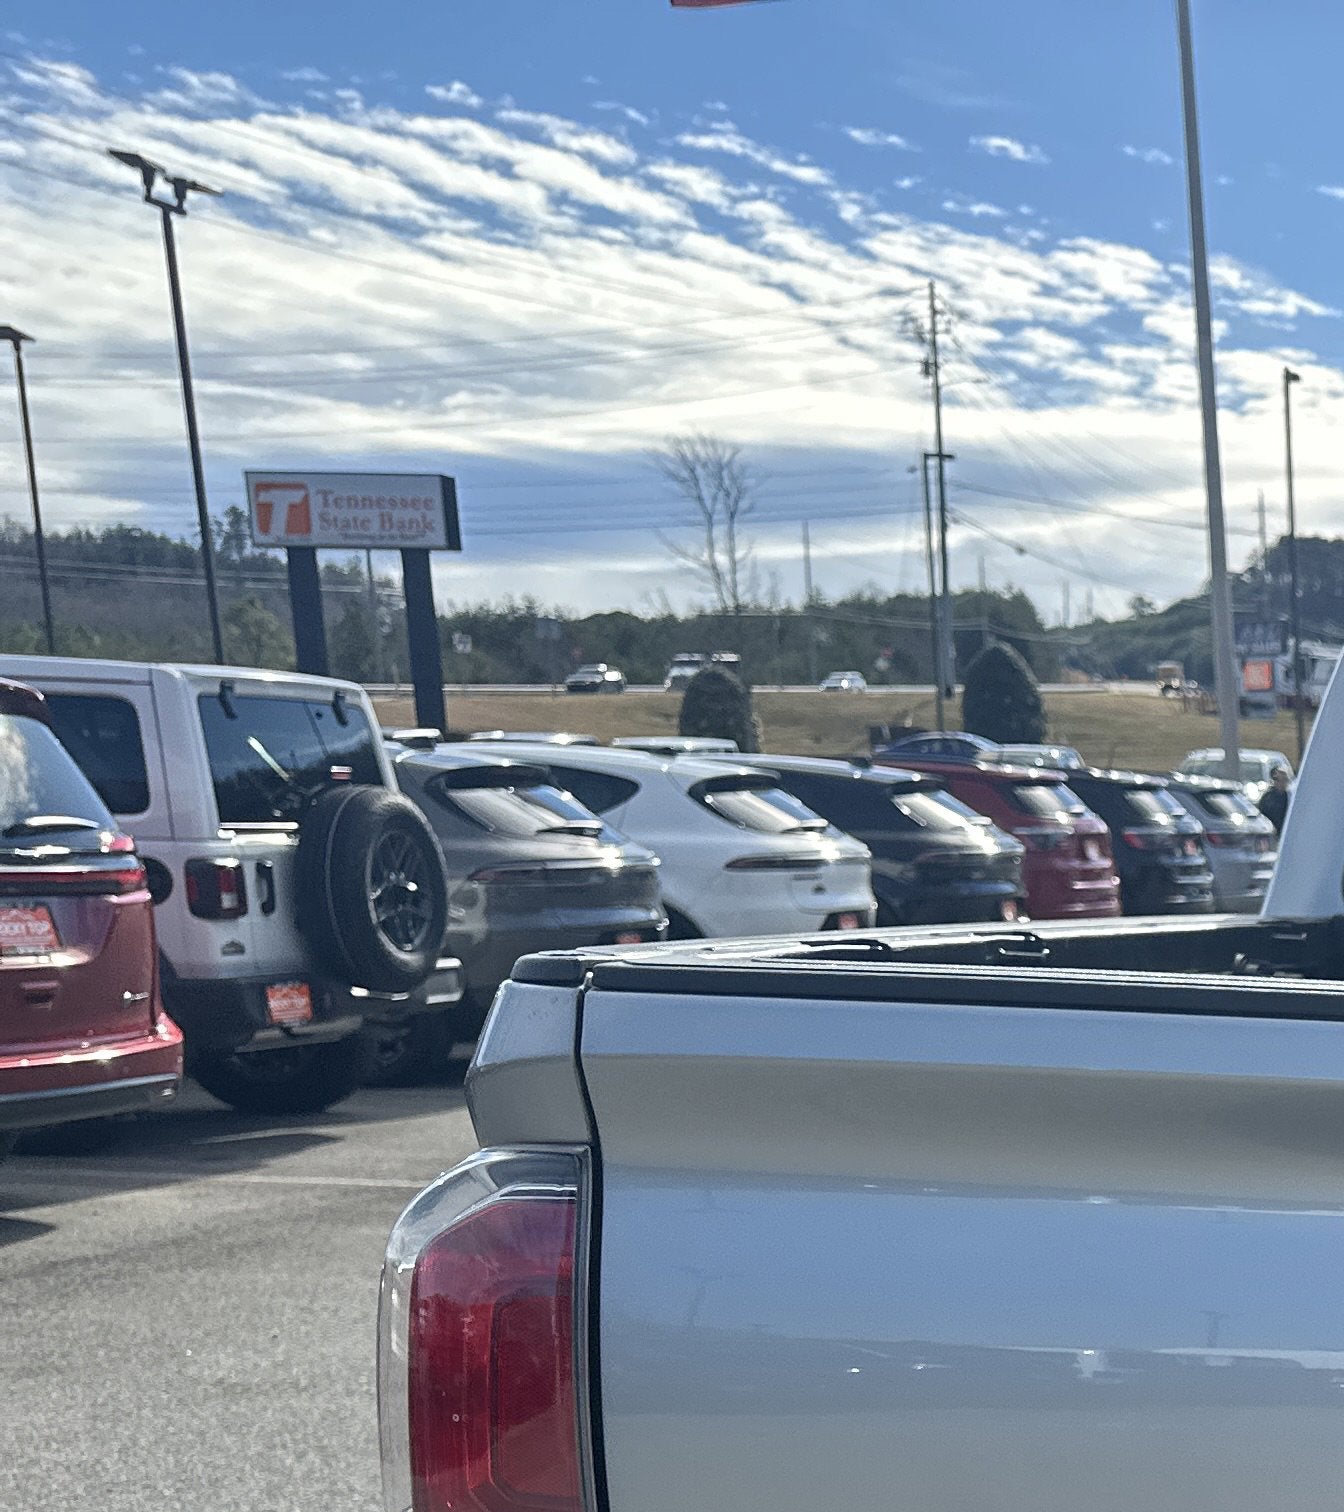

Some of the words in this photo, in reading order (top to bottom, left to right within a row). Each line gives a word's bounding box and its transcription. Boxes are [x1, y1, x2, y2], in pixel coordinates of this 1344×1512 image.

[316, 488, 435, 510] Tennessee
[317, 512, 372, 531] State
[377, 511, 435, 532] Bank
